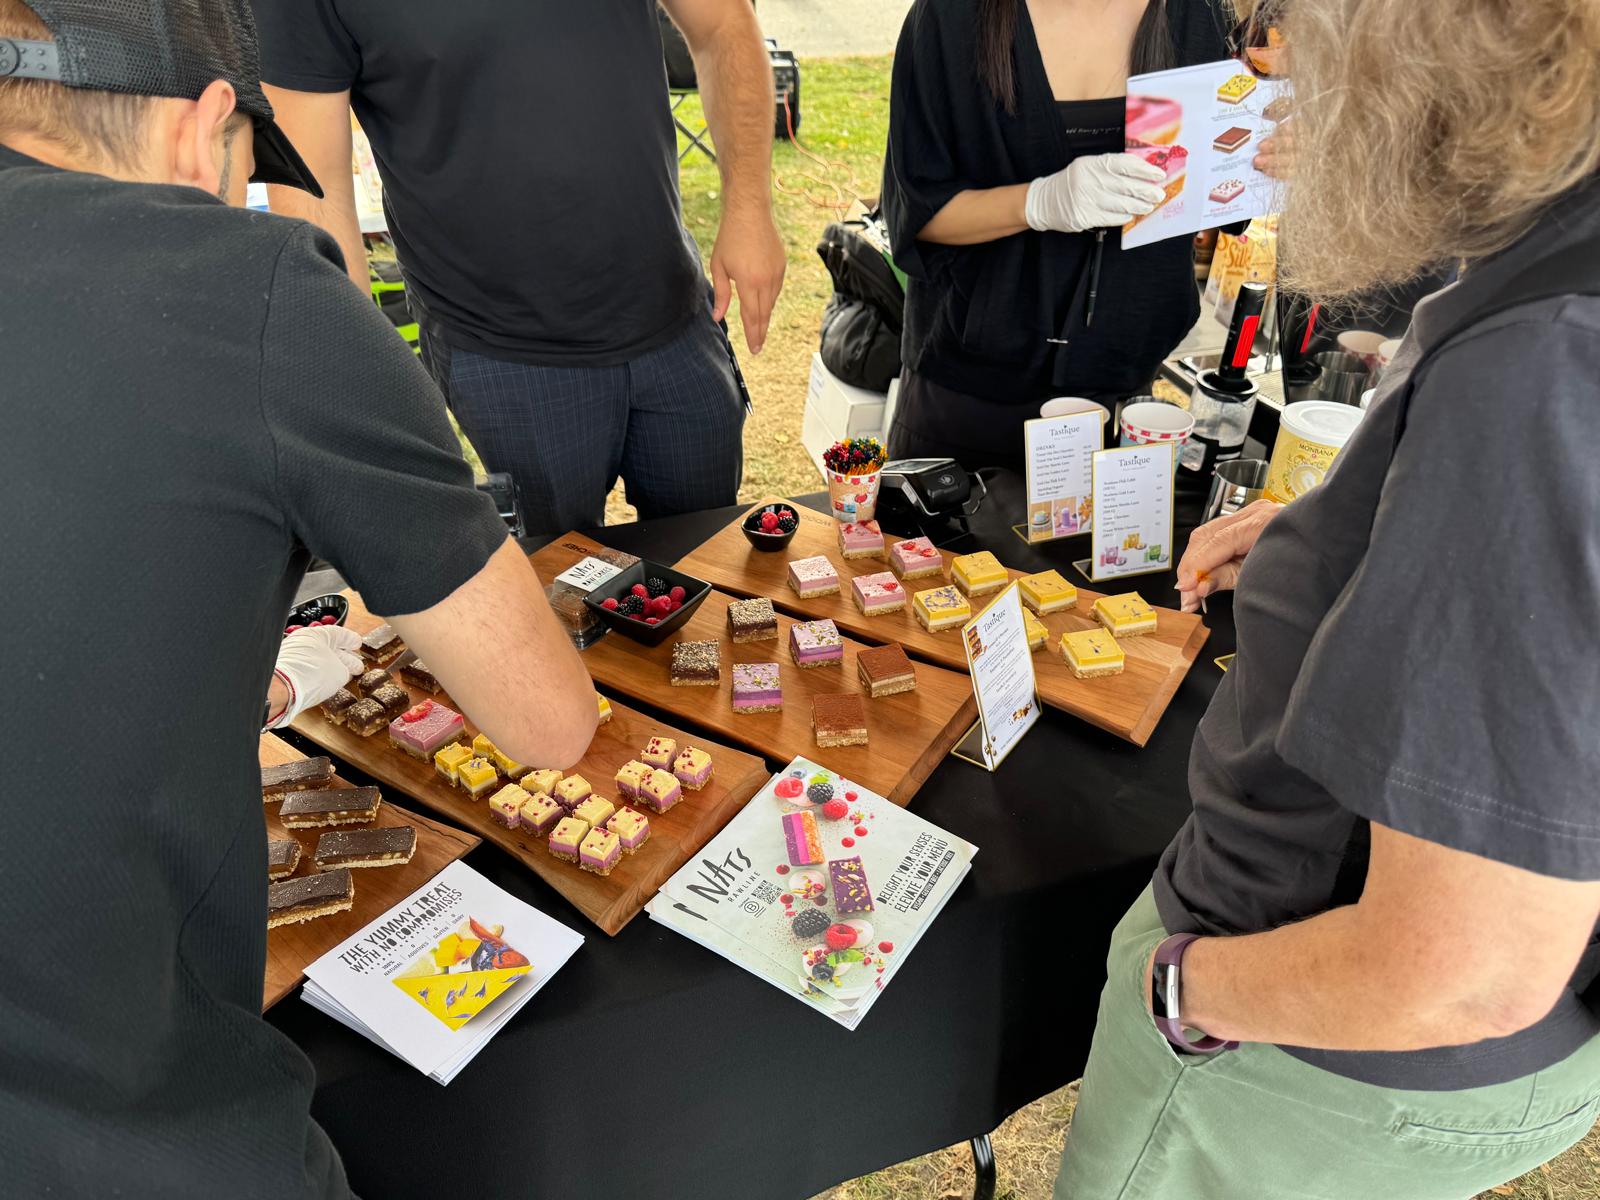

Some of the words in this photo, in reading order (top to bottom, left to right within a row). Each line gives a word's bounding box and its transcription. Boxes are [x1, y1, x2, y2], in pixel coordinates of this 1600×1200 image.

[1048, 425, 1080, 437] Tastique
[1299, 443, 1334, 457] MONBANA
[1119, 455, 1151, 467] Tastique
[983, 609, 1006, 632] Tastique
[686, 847, 752, 904] NATS
[727, 871, 761, 903] RAWLINE
[876, 874, 903, 904] DELIGHT
[896, 855, 916, 875] YOUR
[909, 832, 933, 856] SENSES
[894, 881, 922, 913] ELEVATE
[914, 861, 935, 881] YOUR
[927, 839, 948, 862] MENU
[337, 943, 369, 966] THE
[364, 907, 416, 945] YUMMY
[412, 881, 451, 911] TREAT
[350, 949, 381, 973] WITH
[380, 938, 397, 952] NO
[395, 888, 463, 940] COMPROMISES
